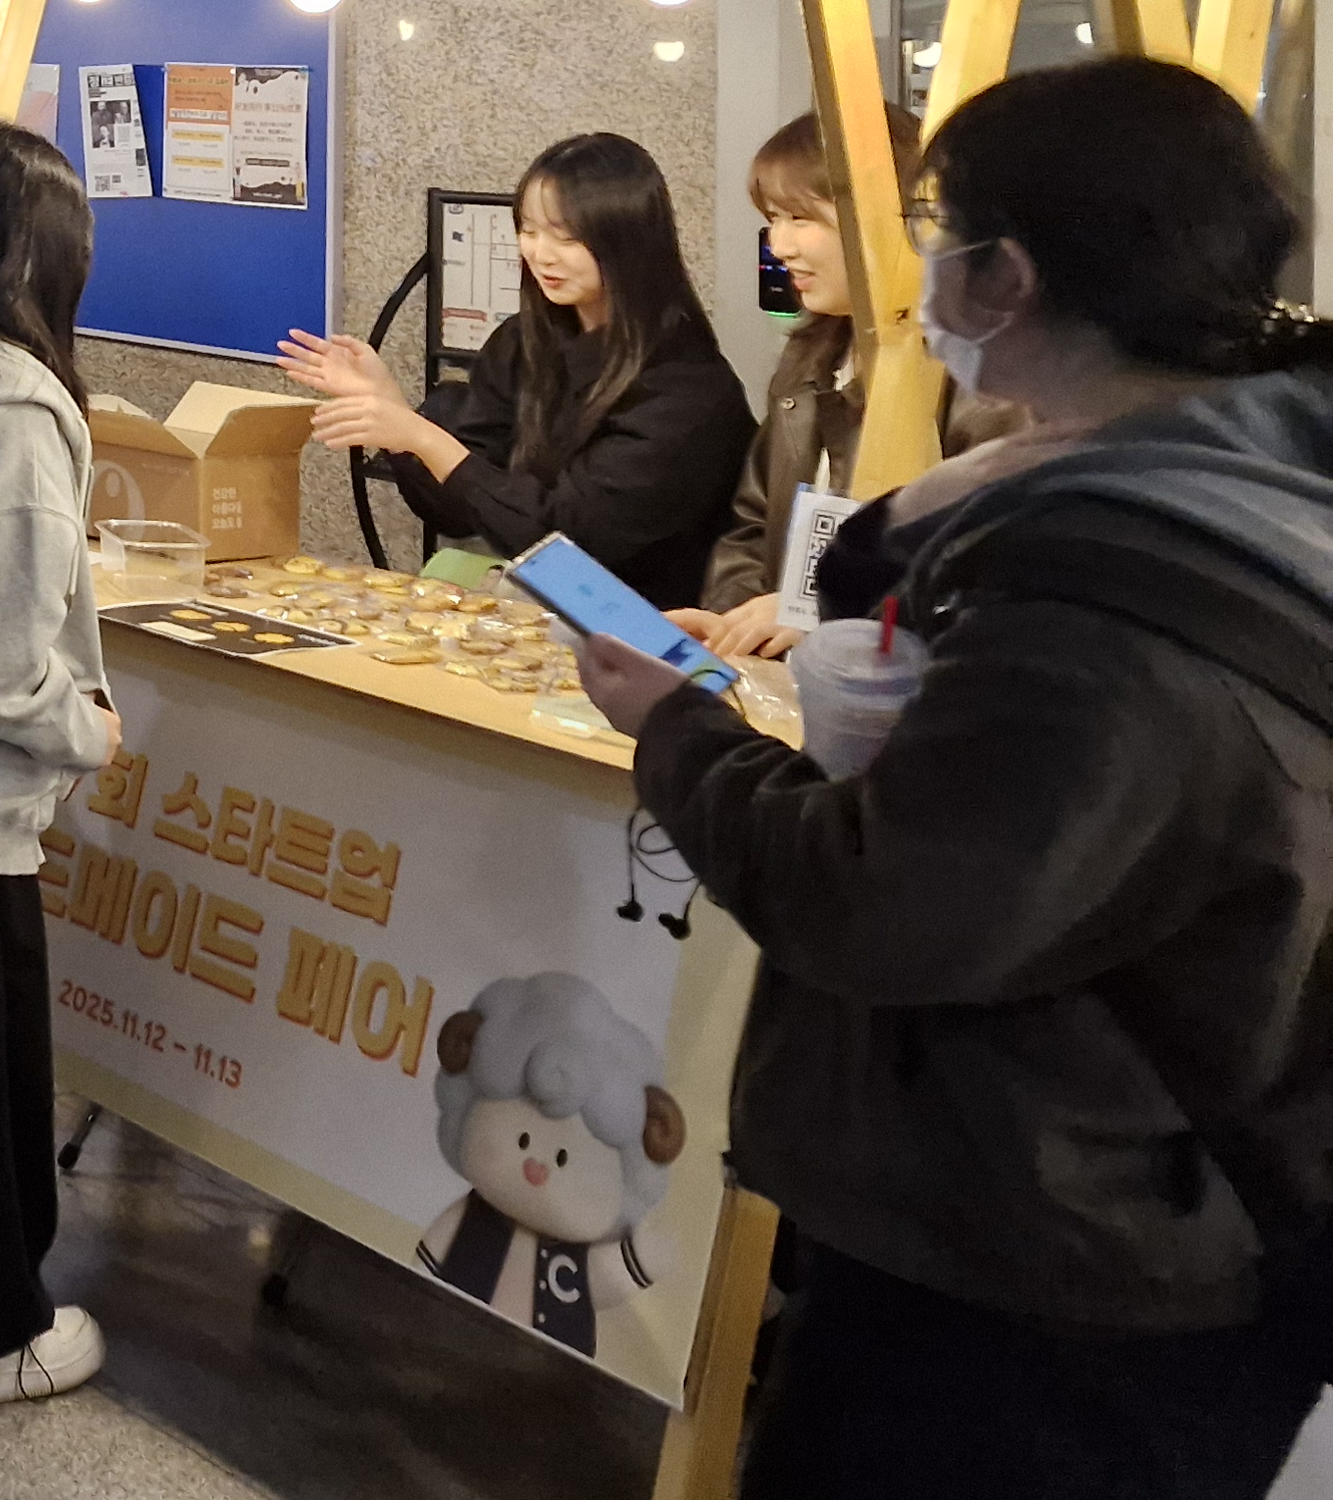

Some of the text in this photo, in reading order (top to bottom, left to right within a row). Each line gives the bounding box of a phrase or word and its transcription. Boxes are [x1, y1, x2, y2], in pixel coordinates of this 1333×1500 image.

[153, 771, 402, 927] 스타트업
[38, 826, 435, 1078] 드메이드 페어
[57, 979, 166, 1053] 2025.11.12
[193, 1042, 244, 1089] 11.13
